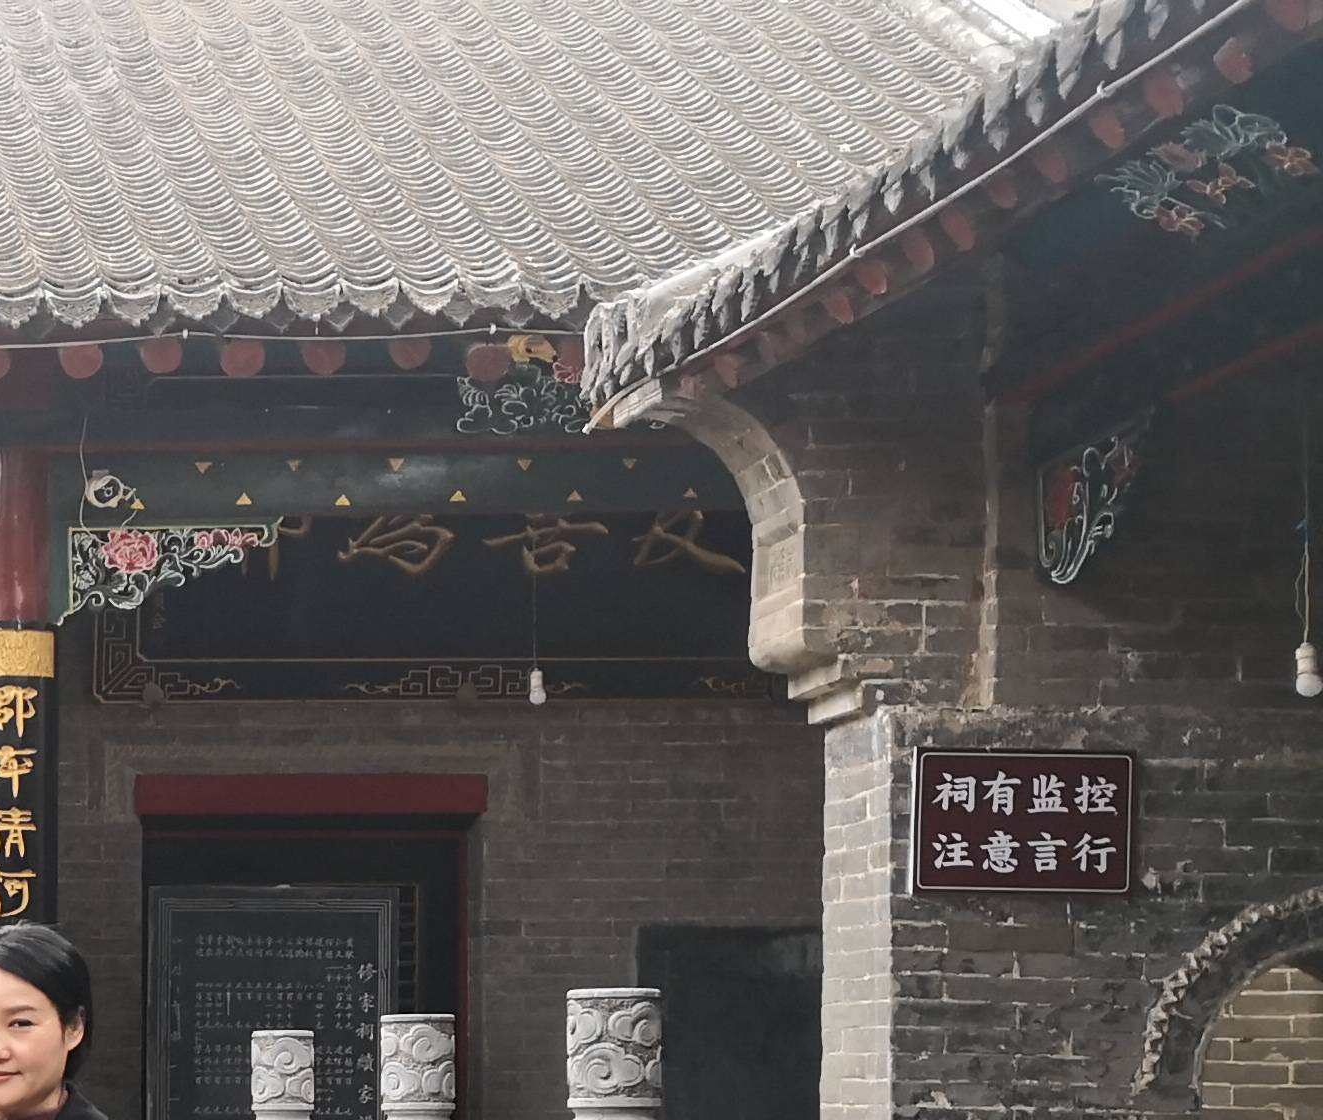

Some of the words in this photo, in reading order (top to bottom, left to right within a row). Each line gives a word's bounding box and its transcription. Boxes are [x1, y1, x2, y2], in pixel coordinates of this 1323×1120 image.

[931, 770, 1120, 816] 祠有监控
[931, 829, 1118, 875] 注意言行
